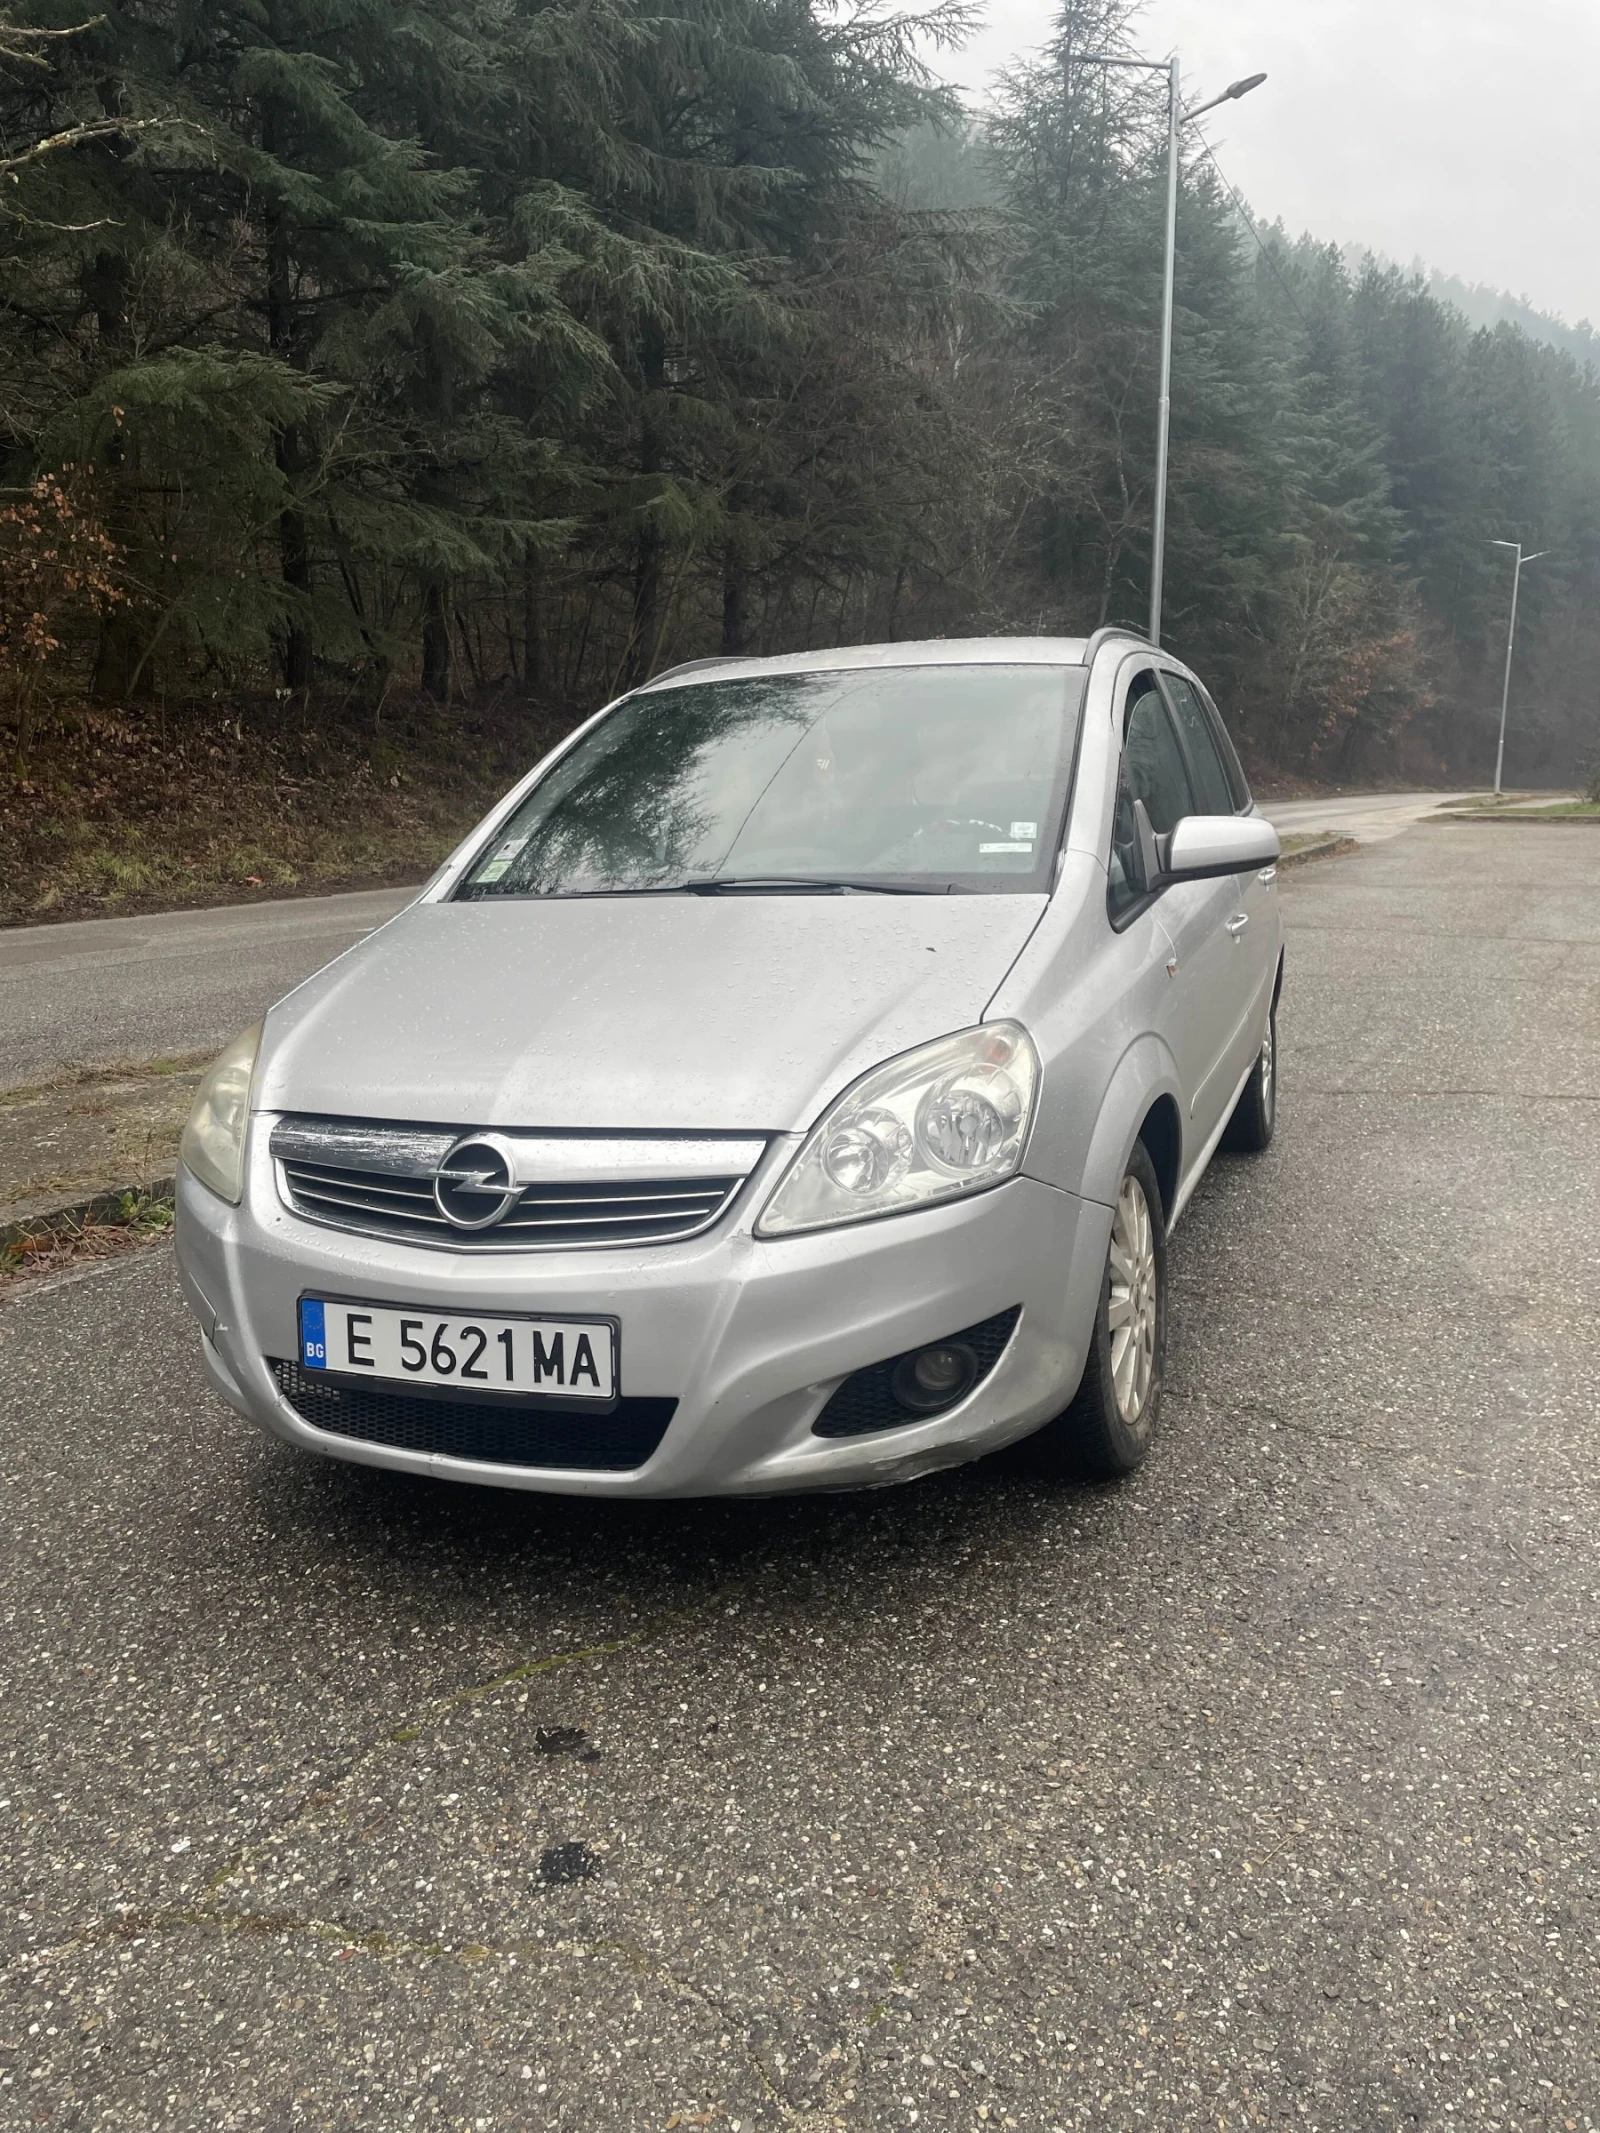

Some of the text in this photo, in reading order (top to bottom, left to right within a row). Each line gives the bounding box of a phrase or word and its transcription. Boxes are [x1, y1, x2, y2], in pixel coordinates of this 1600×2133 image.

[306, 1341, 325, 1359] BG
[346, 1312, 601, 1387] E 5621 MA
